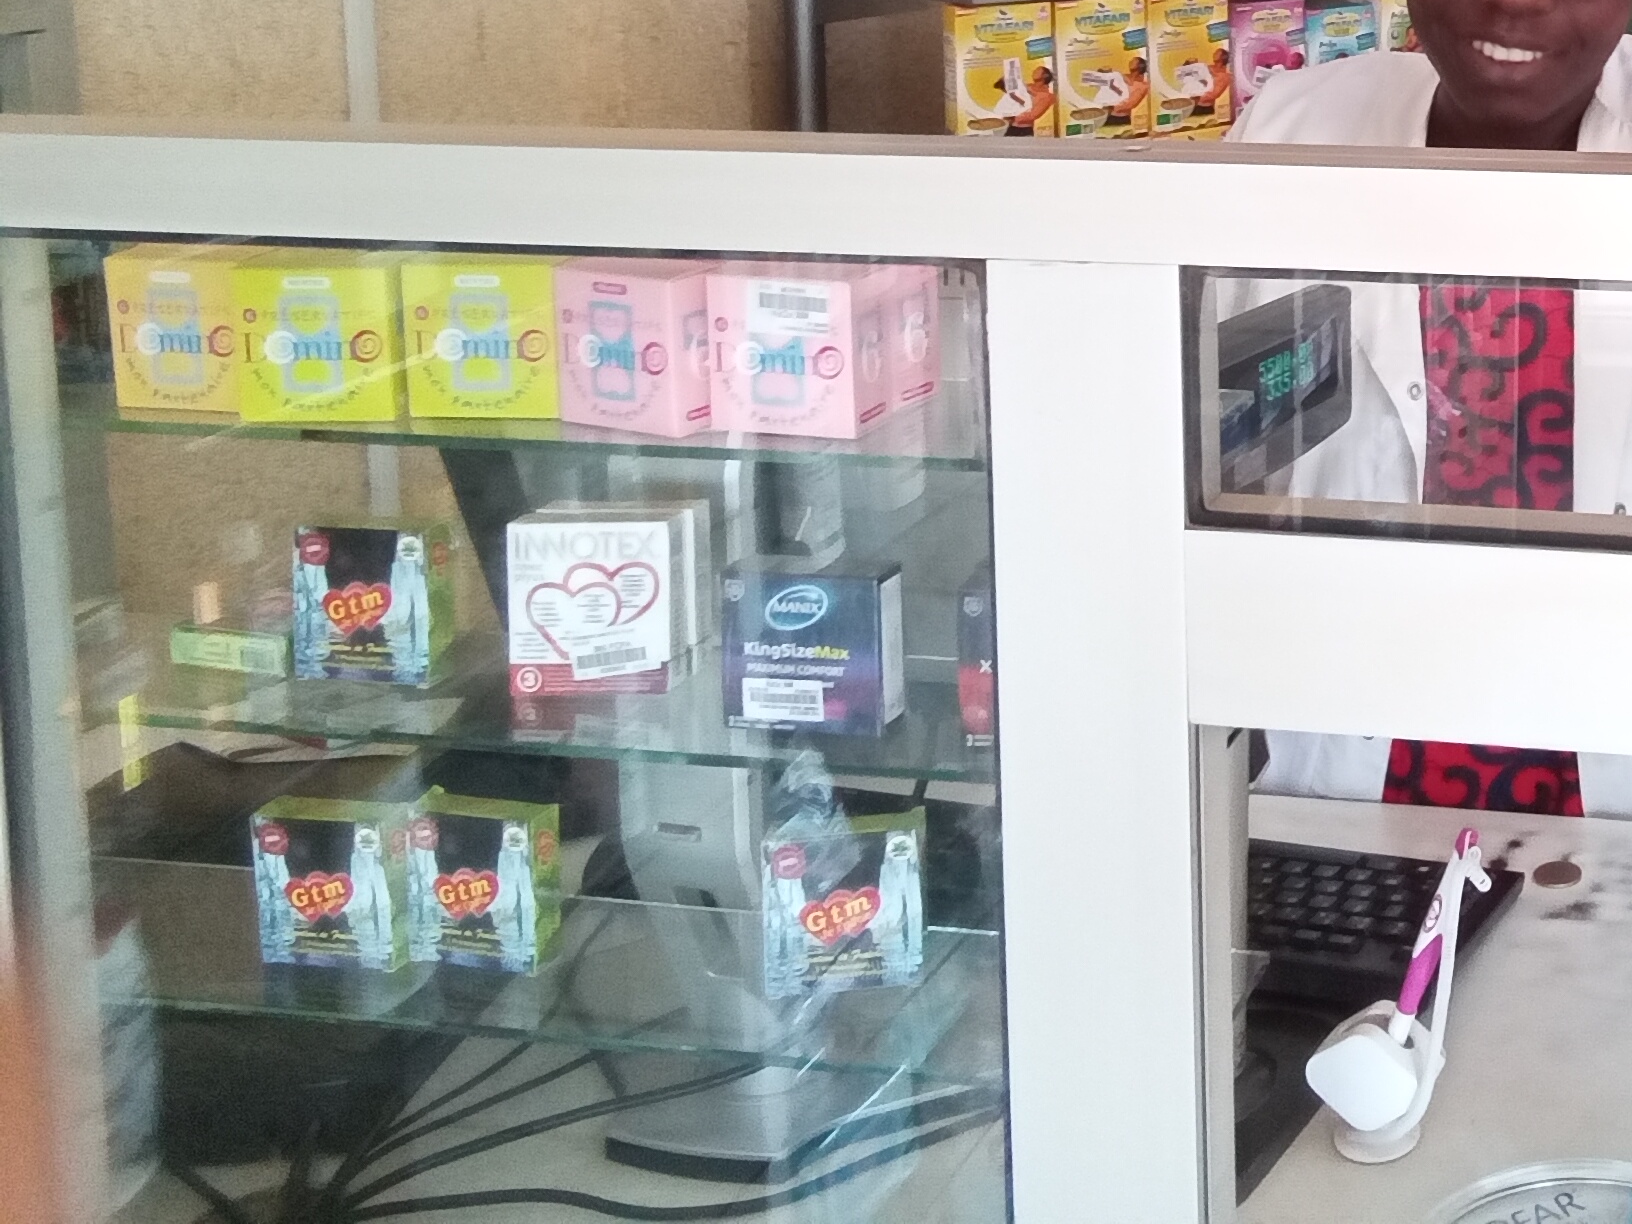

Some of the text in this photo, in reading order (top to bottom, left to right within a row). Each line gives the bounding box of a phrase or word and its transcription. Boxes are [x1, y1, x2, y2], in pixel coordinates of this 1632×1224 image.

[327, 589, 384, 621] Gtm
[772, 599, 823, 616] MANIX
[291, 878, 346, 908] Gtm
[438, 877, 492, 905] Gtm
[806, 896, 872, 932] Gtm
